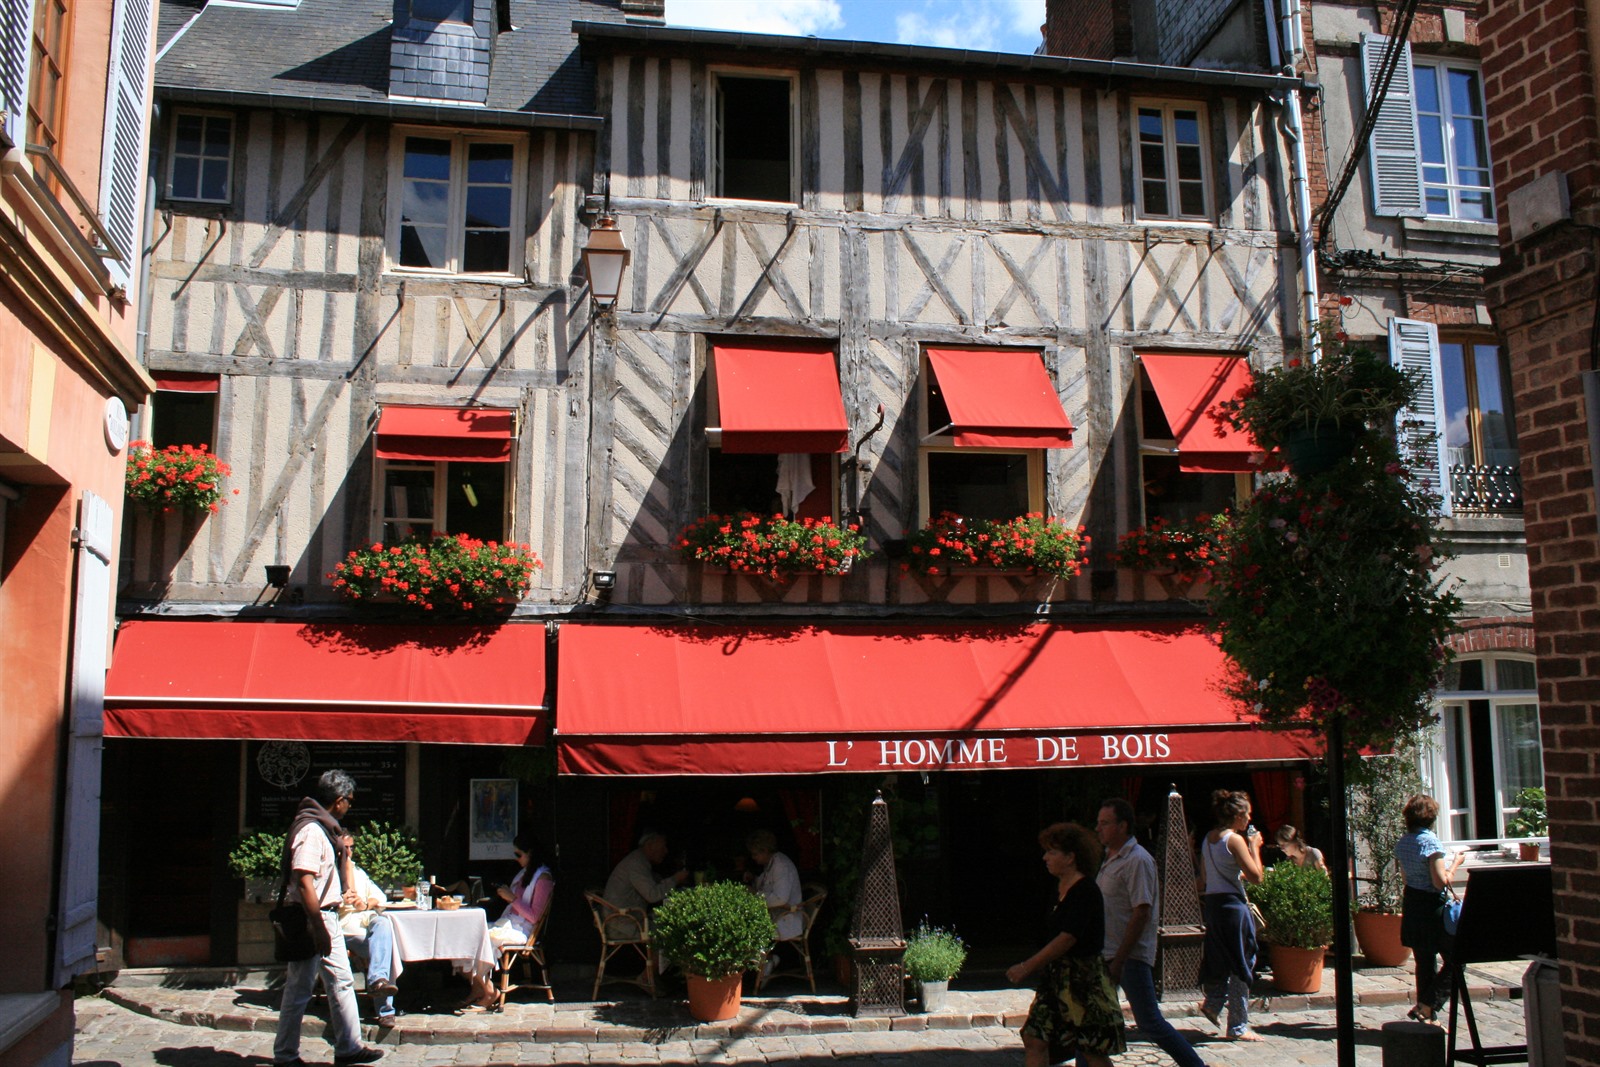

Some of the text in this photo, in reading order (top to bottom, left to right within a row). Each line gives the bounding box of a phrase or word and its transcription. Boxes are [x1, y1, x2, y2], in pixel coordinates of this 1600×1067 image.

[877, 738, 1008, 766] HOMME
[1034, 736, 1080, 763] DE
[1100, 733, 1171, 760] BOIS
